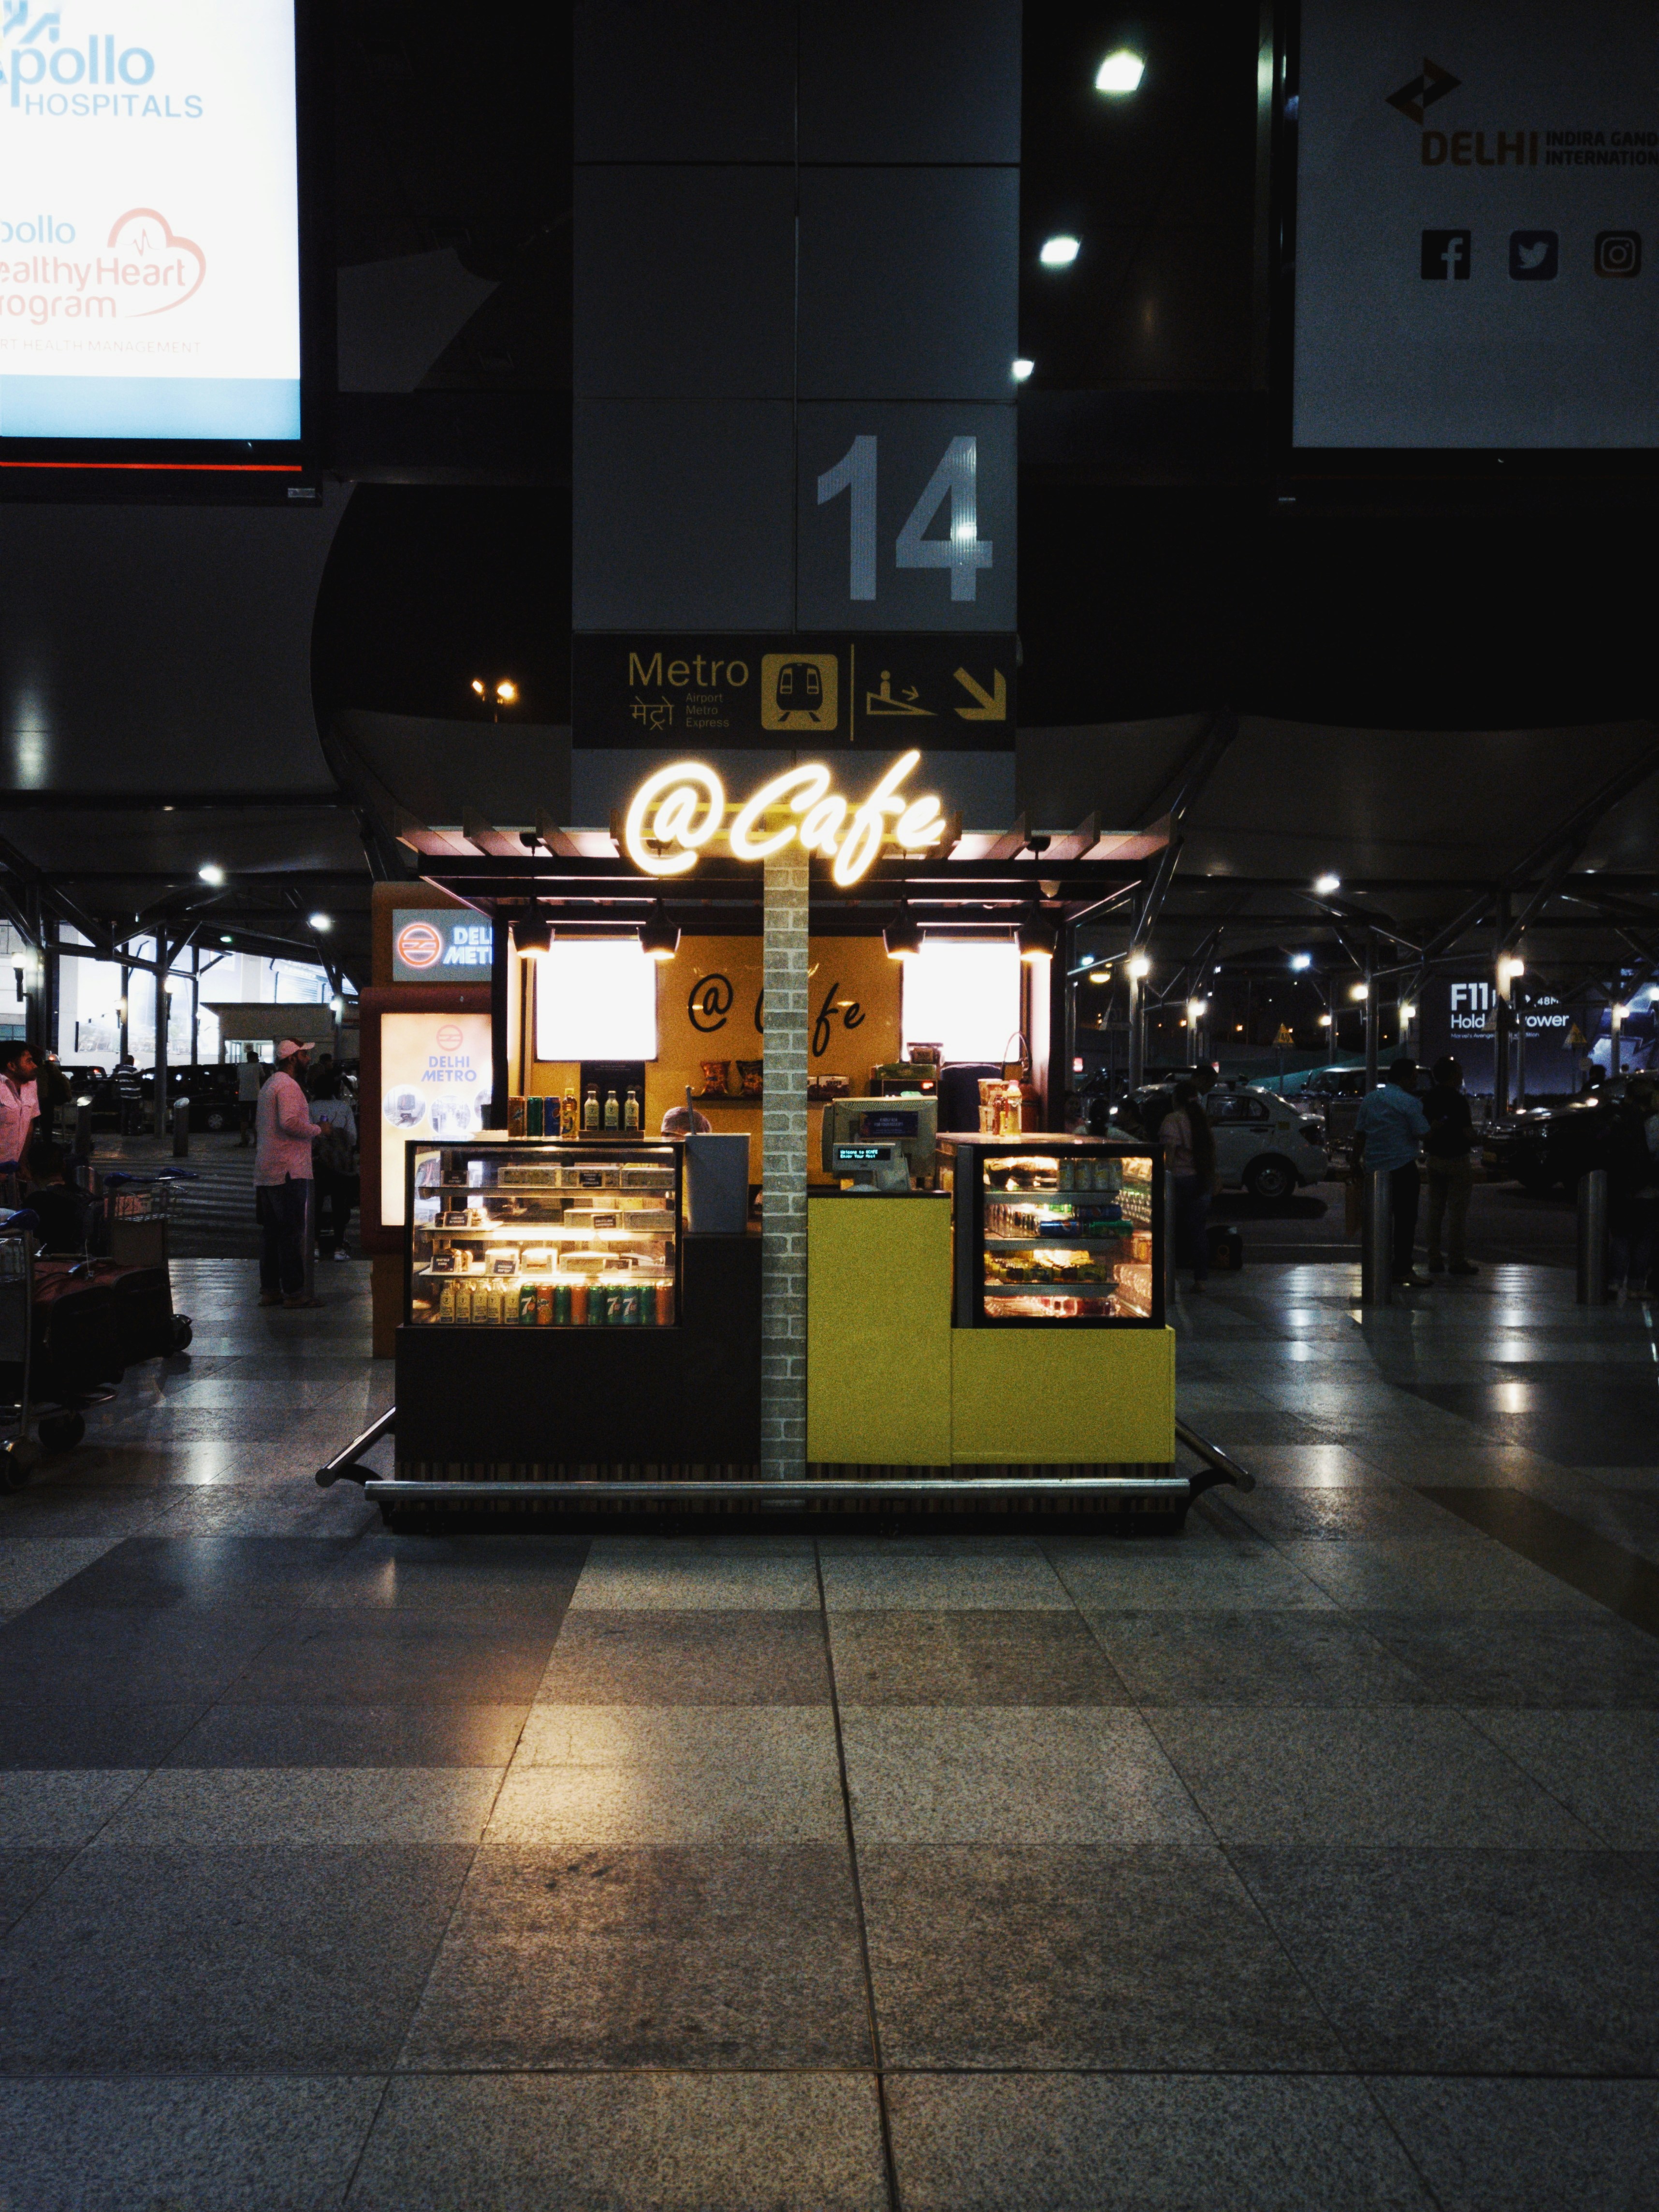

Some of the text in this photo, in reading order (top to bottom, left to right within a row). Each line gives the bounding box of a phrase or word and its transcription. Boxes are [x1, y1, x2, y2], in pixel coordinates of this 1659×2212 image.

[25, 93, 203, 118] HOSPITALS
[1546, 131, 1605, 146] INDIRA
[1421, 131, 1538, 166] DELHI
[23, 339, 83, 351] HEALTH
[88, 340, 202, 353] MANAGEMENT
[817, 435, 993, 601] 14
[629, 652, 749, 686] Metro
[685, 693, 724, 704] Airport
[629, 696, 675, 730] मेट्रो
[685, 705, 719, 715] Metro
[685, 717, 730, 728] Express
[1451, 983, 1488, 1011] F11
[754, 982, 866, 1057] fe
[1451, 1013, 1570, 1029] Hold ower
[428, 1056, 470, 1068] DELHI
[421, 1070, 477, 1082] METRO
